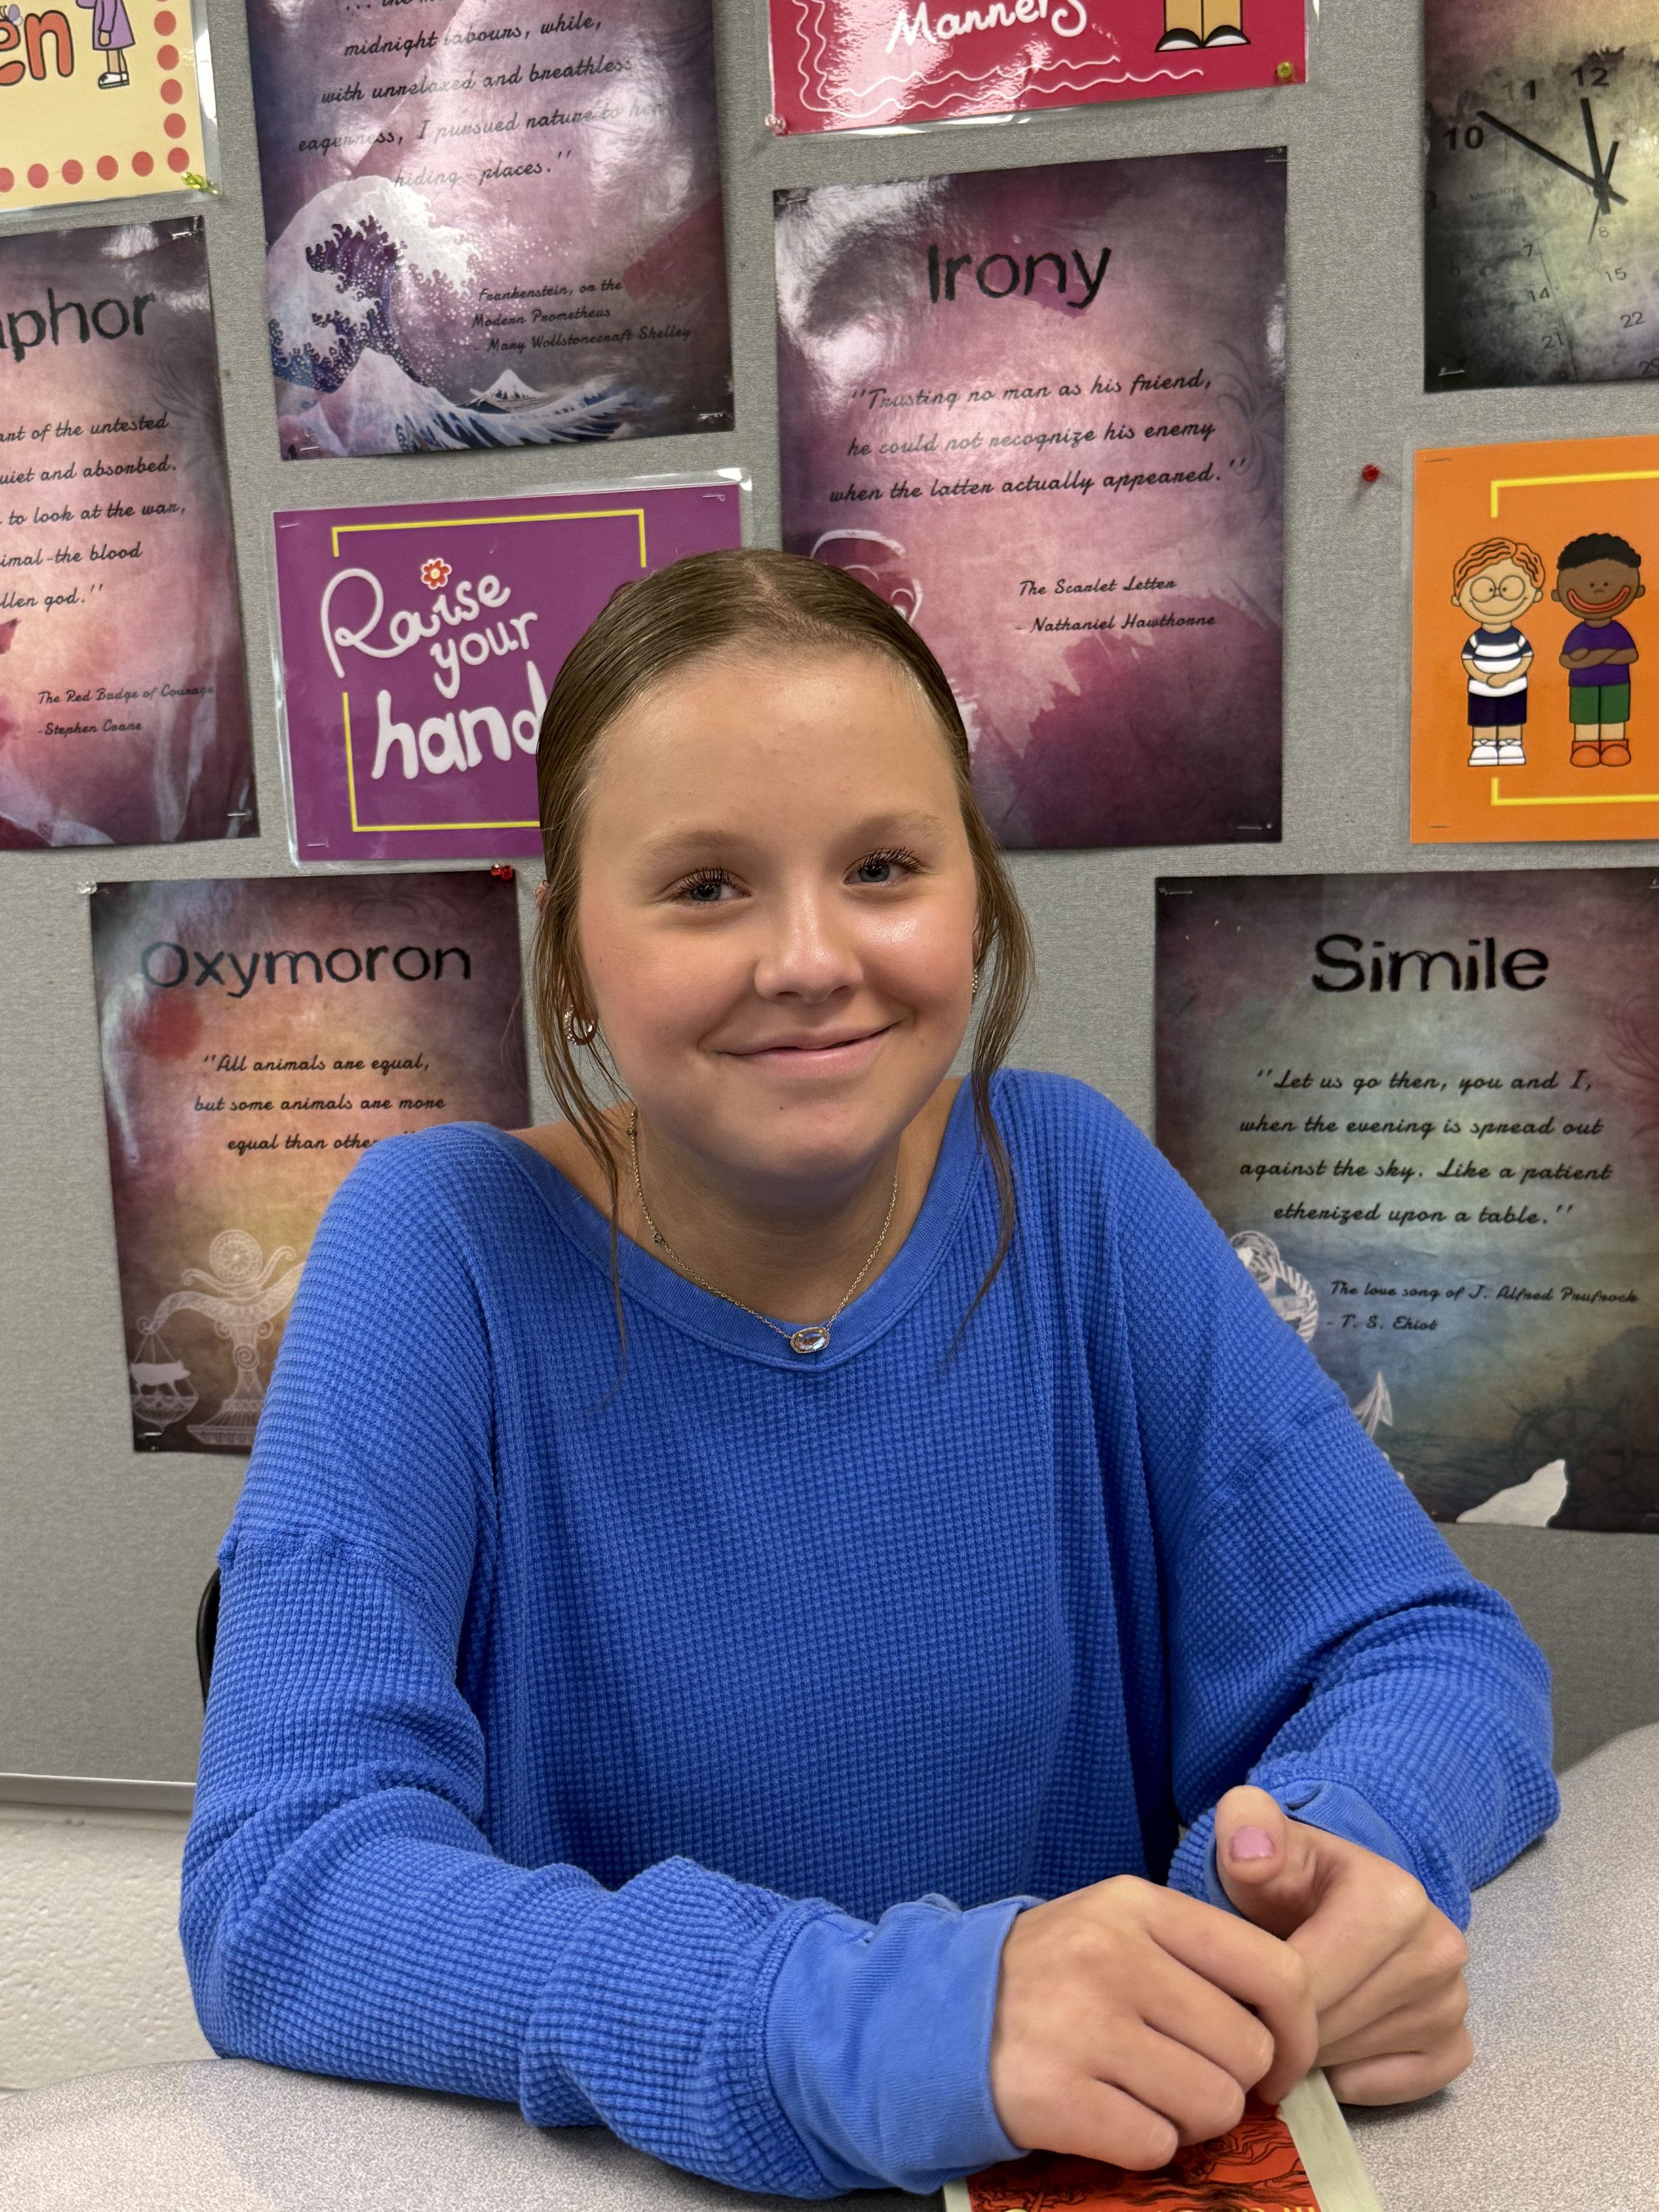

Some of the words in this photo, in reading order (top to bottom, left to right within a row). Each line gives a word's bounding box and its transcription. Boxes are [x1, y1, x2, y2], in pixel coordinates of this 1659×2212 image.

[344, 31, 439, 57] midnight
[443, 25, 530, 46] labours,
[540, 11, 601, 35] while,
[321, 82, 364, 104] with
[372, 70, 476, 99] unrelaxed
[482, 66, 522, 88] and
[1571, 66, 1609, 87] 12
[299, 131, 403, 156] eagerness,
[417, 120, 430, 139] I
[434, 112, 519, 145] pursued
[526, 109, 595, 129] nature
[1443, 126, 1484, 151] 10
[928, 244, 1112, 309] Irony
[1528, 287, 1550, 303] 14
[1606, 267, 1626, 282] 15
[478, 285, 573, 302] Frankenstein,
[579, 285, 596, 293] or
[601, 279, 623, 291] the
[472, 315, 526, 328] Modern
[532, 306, 611, 324] Prometheus
[1542, 332, 1563, 349] 21
[1621, 311, 1645, 329] 22
[486, 338, 526, 354] Mary
[532, 329, 634, 348] Wollstonecraft
[638, 325, 692, 342] Shelley
[968, 390, 994, 403] no
[1003, 387, 1050, 400] man
[1058, 384, 1082, 396] as
[1090, 375, 1121, 394] his
[1129, 368, 1212, 395] friend,
[31, 423, 52, 443] of
[55, 419, 84, 438] the
[90, 411, 170, 434] untested
[847, 437, 871, 456] he
[879, 432, 939, 454] could
[946, 432, 983, 451] not
[989, 429, 1097, 452] recognize
[1104, 422, 1135, 440] his
[1145, 423, 1216, 442] enemy
[40, 461, 77, 480] and
[83, 454, 177, 477] absorbed.
[829, 483, 883, 502] when
[891, 480, 922, 498] the
[930, 479, 994, 496] latter
[1002, 470, 1094, 495] actually
[9, 510, 27, 526] to
[33, 504, 74, 524] look
[80, 504, 102, 520] at
[107, 500, 135, 518] the
[142, 502, 186, 516] war,
[90, 541, 143, 561] blood
[1019, 580, 1046, 596] The
[1054, 579, 1118, 594] Scarlet
[1123, 575, 1177, 591] Letter
[321, 567, 511, 678] Raise
[1030, 615, 1115, 632] Nathaniel
[1121, 613, 1216, 629] Hawthorne
[429, 612, 538, 699] your
[38, 690, 60, 704] The
[66, 690, 92, 702] Red
[96, 686, 139, 703] Badge
[143, 687, 157, 700] of
[161, 684, 214, 698] Courage
[104, 719, 143, 731] Crane
[371, 660, 548, 779] hand
[141, 941, 471, 998] Oxymoron
[1312, 934, 1549, 992] Simile
[253, 1055, 325, 1071] animals
[333, 1060, 365, 1070] are
[372, 1053, 429, 1076] equal,
[1320, 1078, 1342, 1089] us
[1353, 1078, 1382, 1095] go
[1390, 1070, 1447, 1092] then,
[1459, 1078, 1502, 1096] you
[1510, 1071, 1558, 1089] and
[1570, 1070, 1592, 1092] I,
[194, 1096, 225, 1111] but
[230, 1100, 274, 1111] some
[281, 1094, 352, 1110] animals
[360, 1100, 392, 1110] are
[399, 1098, 446, 1110] more
[1239, 1114, 1297, 1132] when
[1304, 1115, 1338, 1132] the
[1346, 1120, 1436, 1140] evening
[1443, 1119, 1461, 1134] is
[1470, 1116, 1555, 1139] spread
[1563, 1118, 1604, 1135] out
[228, 1134, 279, 1156] equal
[285, 1134, 328, 1149] than
[1240, 1159, 1327, 1182] against
[1333, 1159, 1368, 1177] the
[1374, 1159, 1423, 1185] sky.
[1436, 1158, 1491, 1178] Like
[1499, 1167, 1516, 1179] a
[1520, 1163, 1613, 1185] patient
[1273, 1202, 1380, 1226] etherized
[1388, 1210, 1447, 1226] upon
[1455, 1212, 1471, 1223] a
[1331, 1280, 1358, 1295] The
[1364, 1282, 1398, 1297] love
[1402, 1288, 1441, 1303] song
[1445, 1286, 1466, 1301] of
[1469, 1284, 1488, 1299] J.
[1496, 1284, 1554, 1302] Alfred
[1560, 1286, 1638, 1305] Prufrock
